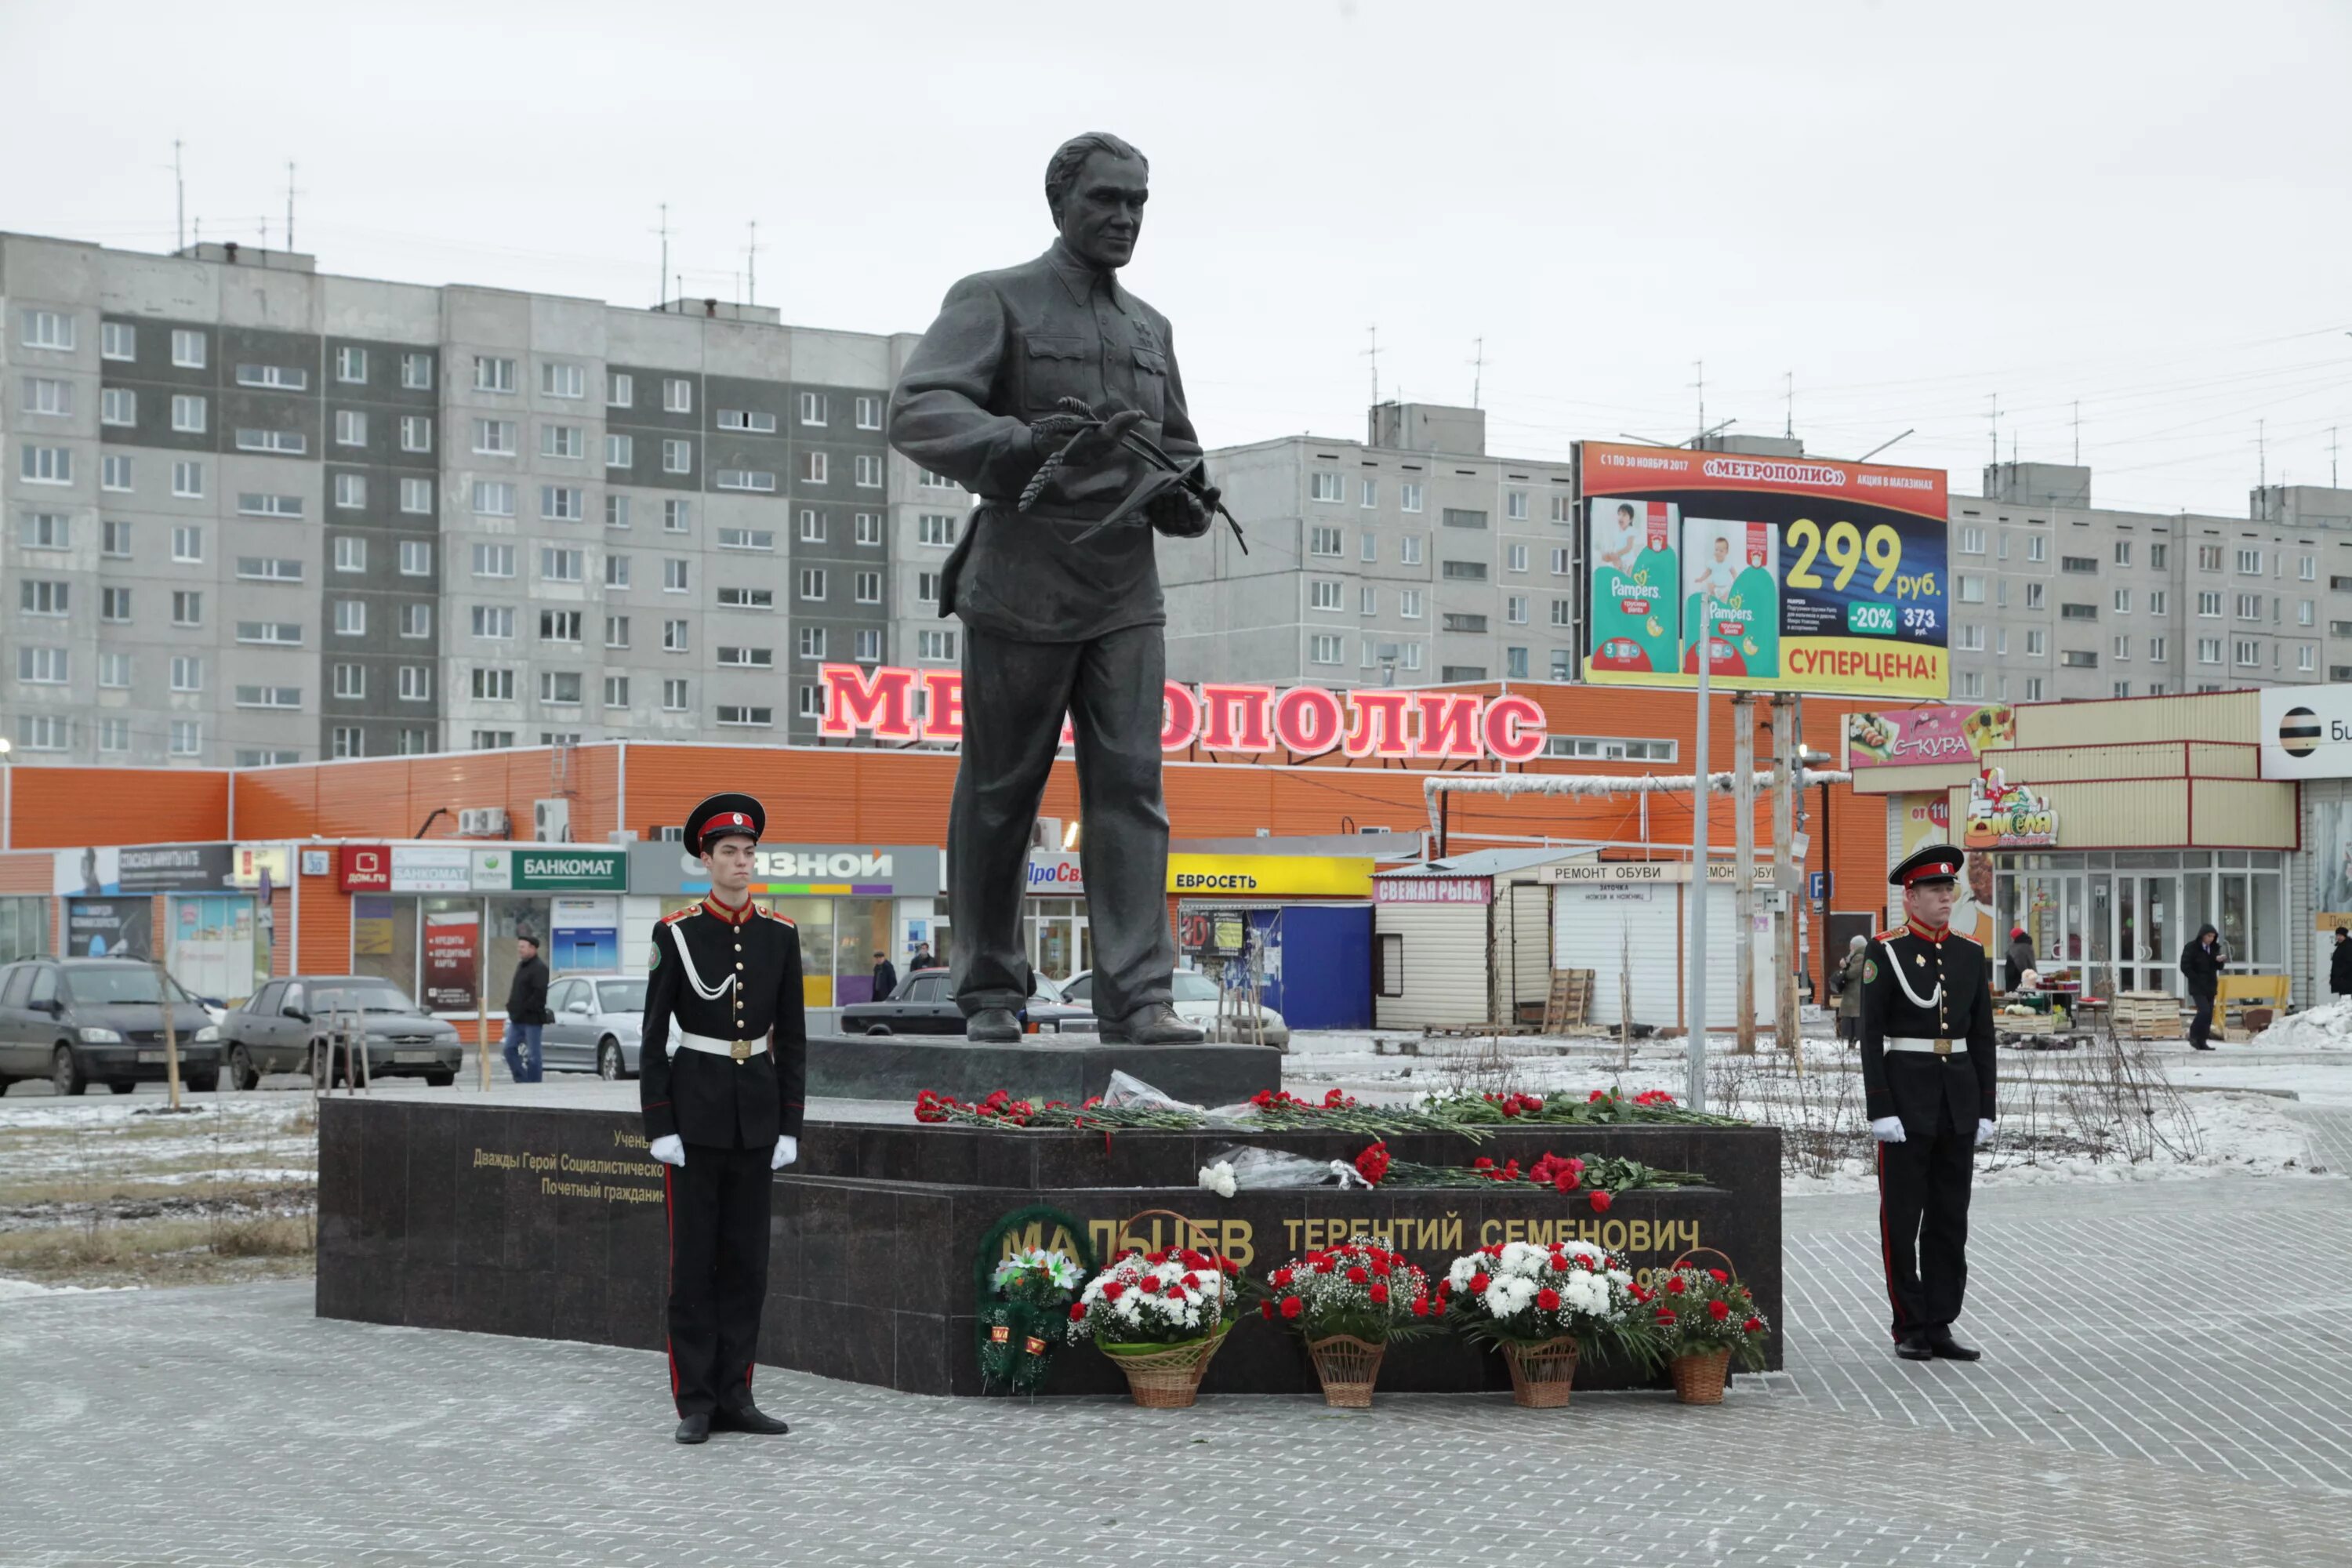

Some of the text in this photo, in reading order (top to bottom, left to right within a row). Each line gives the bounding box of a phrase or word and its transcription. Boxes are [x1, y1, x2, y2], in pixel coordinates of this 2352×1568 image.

[1601, 454, 1688, 470] С 1 ПО 30 НОЯБРЯ 2017
[1704, 460, 1846, 485] «МЕТРОПОЛИС»
[1857, 474, 1933, 490] АКЦИЯ В МАГАЗИНАХ
[1786, 518, 1902, 593] 299
[1612, 576, 1659, 601] Pampers
[1896, 572, 1941, 601] руб.
[1710, 601, 1753, 622] Pampers
[1850, 607, 1893, 629] -20%
[1904, 608, 1936, 628] 373
[1788, 648, 1936, 682] СУПЕРЦЕНА!
[818, 663, 1547, 763] МЕОПОЛИС
[394, 868, 466, 880] БАНКОМАТ
[524, 858, 615, 875] БАНКОМАТ
[1555, 866, 1661, 879] РЕМОНТ ОБУВИ
[1177, 873, 1257, 888] ЕВРОСЕТЬ
[1379, 880, 1482, 901] СВЕЖАЯ РЫБА
[1181, 915, 1207, 947] 3D
[614, 1129, 653, 1149] Учены
[474, 1148, 520, 1169] Дважды
[523, 1152, 557, 1175] Герой
[542, 1178, 601, 1199] Почетный
[1283, 1210, 1462, 1251] ТЕРЕНТИЙ
[1480, 1219, 1699, 1252] СЕМЕНОВИЧ
